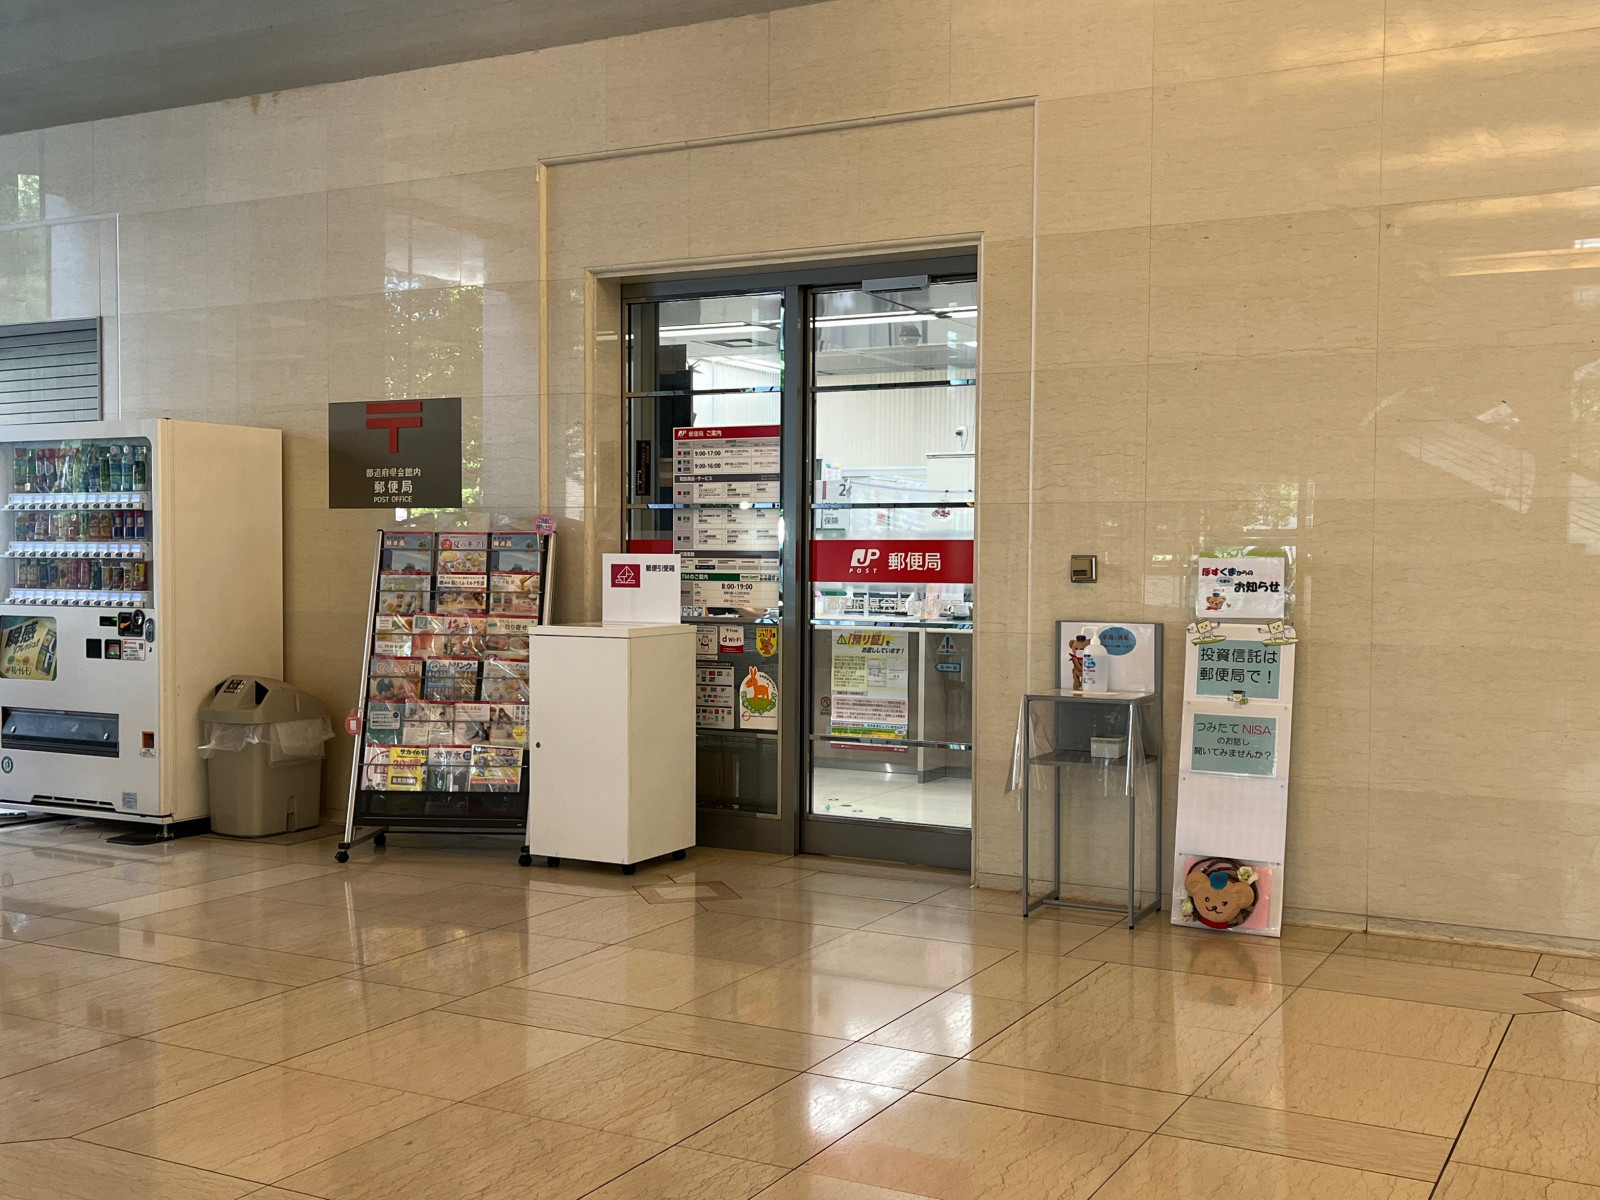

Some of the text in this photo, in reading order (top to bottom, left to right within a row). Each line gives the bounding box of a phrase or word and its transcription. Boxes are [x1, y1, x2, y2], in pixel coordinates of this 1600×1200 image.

[366, 467, 421, 477] 都道府県会館内
[374, 480, 413, 493] 郵便局
[391, 495, 413, 503] OFFICE
[824, 517, 839, 525] 保険
[453, 538, 486, 549] 夏のギフト
[850, 549, 880, 567] JP
[888, 552, 941, 571] 郵便局
[645, 564, 675, 572] 郵便引受箱
[1234, 581, 1280, 593] お知らせ
[1200, 647, 1278, 664] 投資信託は
[1199, 667, 1272, 684] 郵便局で！
[1216, 737, 1250, 746] のお話し
[1193, 747, 1272, 760] 聞いてみませんか？
